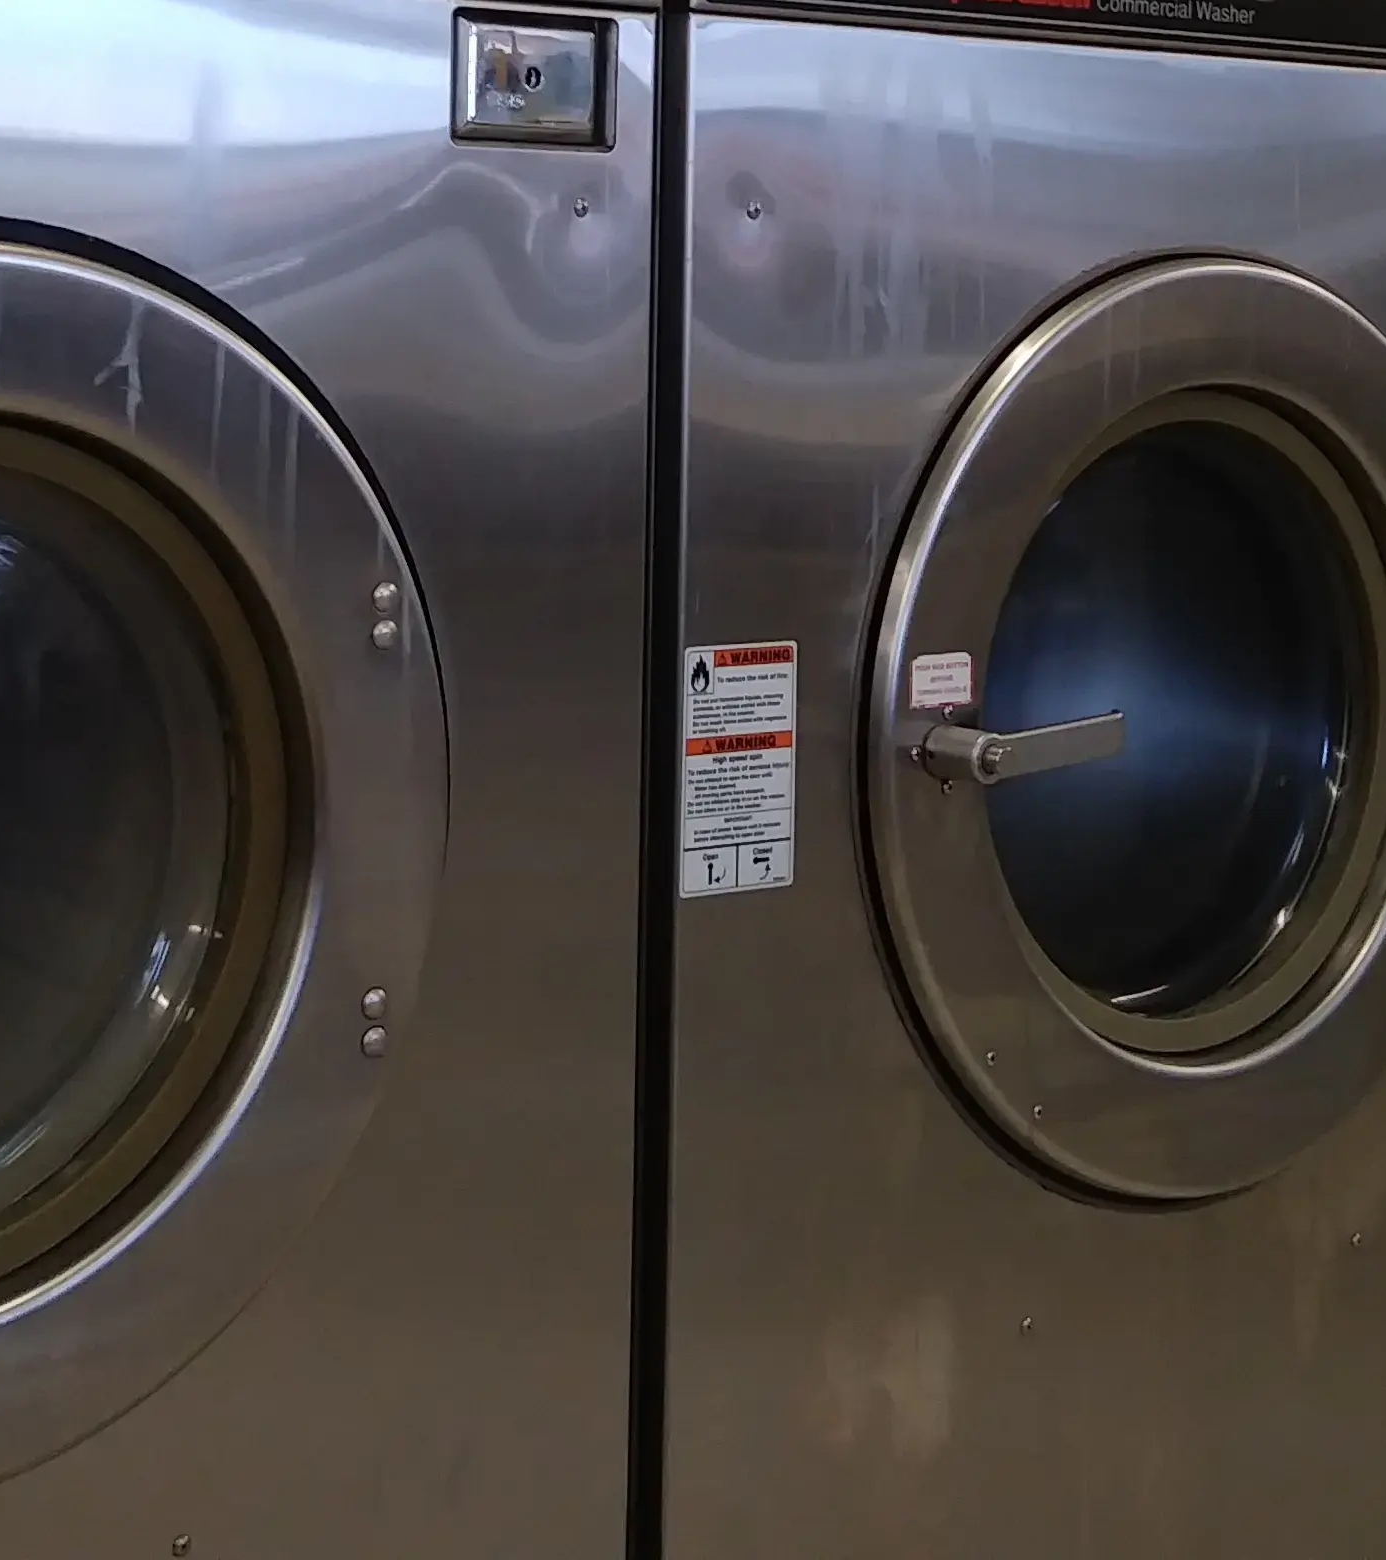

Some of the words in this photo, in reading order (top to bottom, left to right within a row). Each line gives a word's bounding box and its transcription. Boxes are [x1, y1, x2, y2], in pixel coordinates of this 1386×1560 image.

[1196, 2, 1256, 26] Washer
[731, 650, 790, 663] WARNING
[716, 735, 776, 751] WARNING
